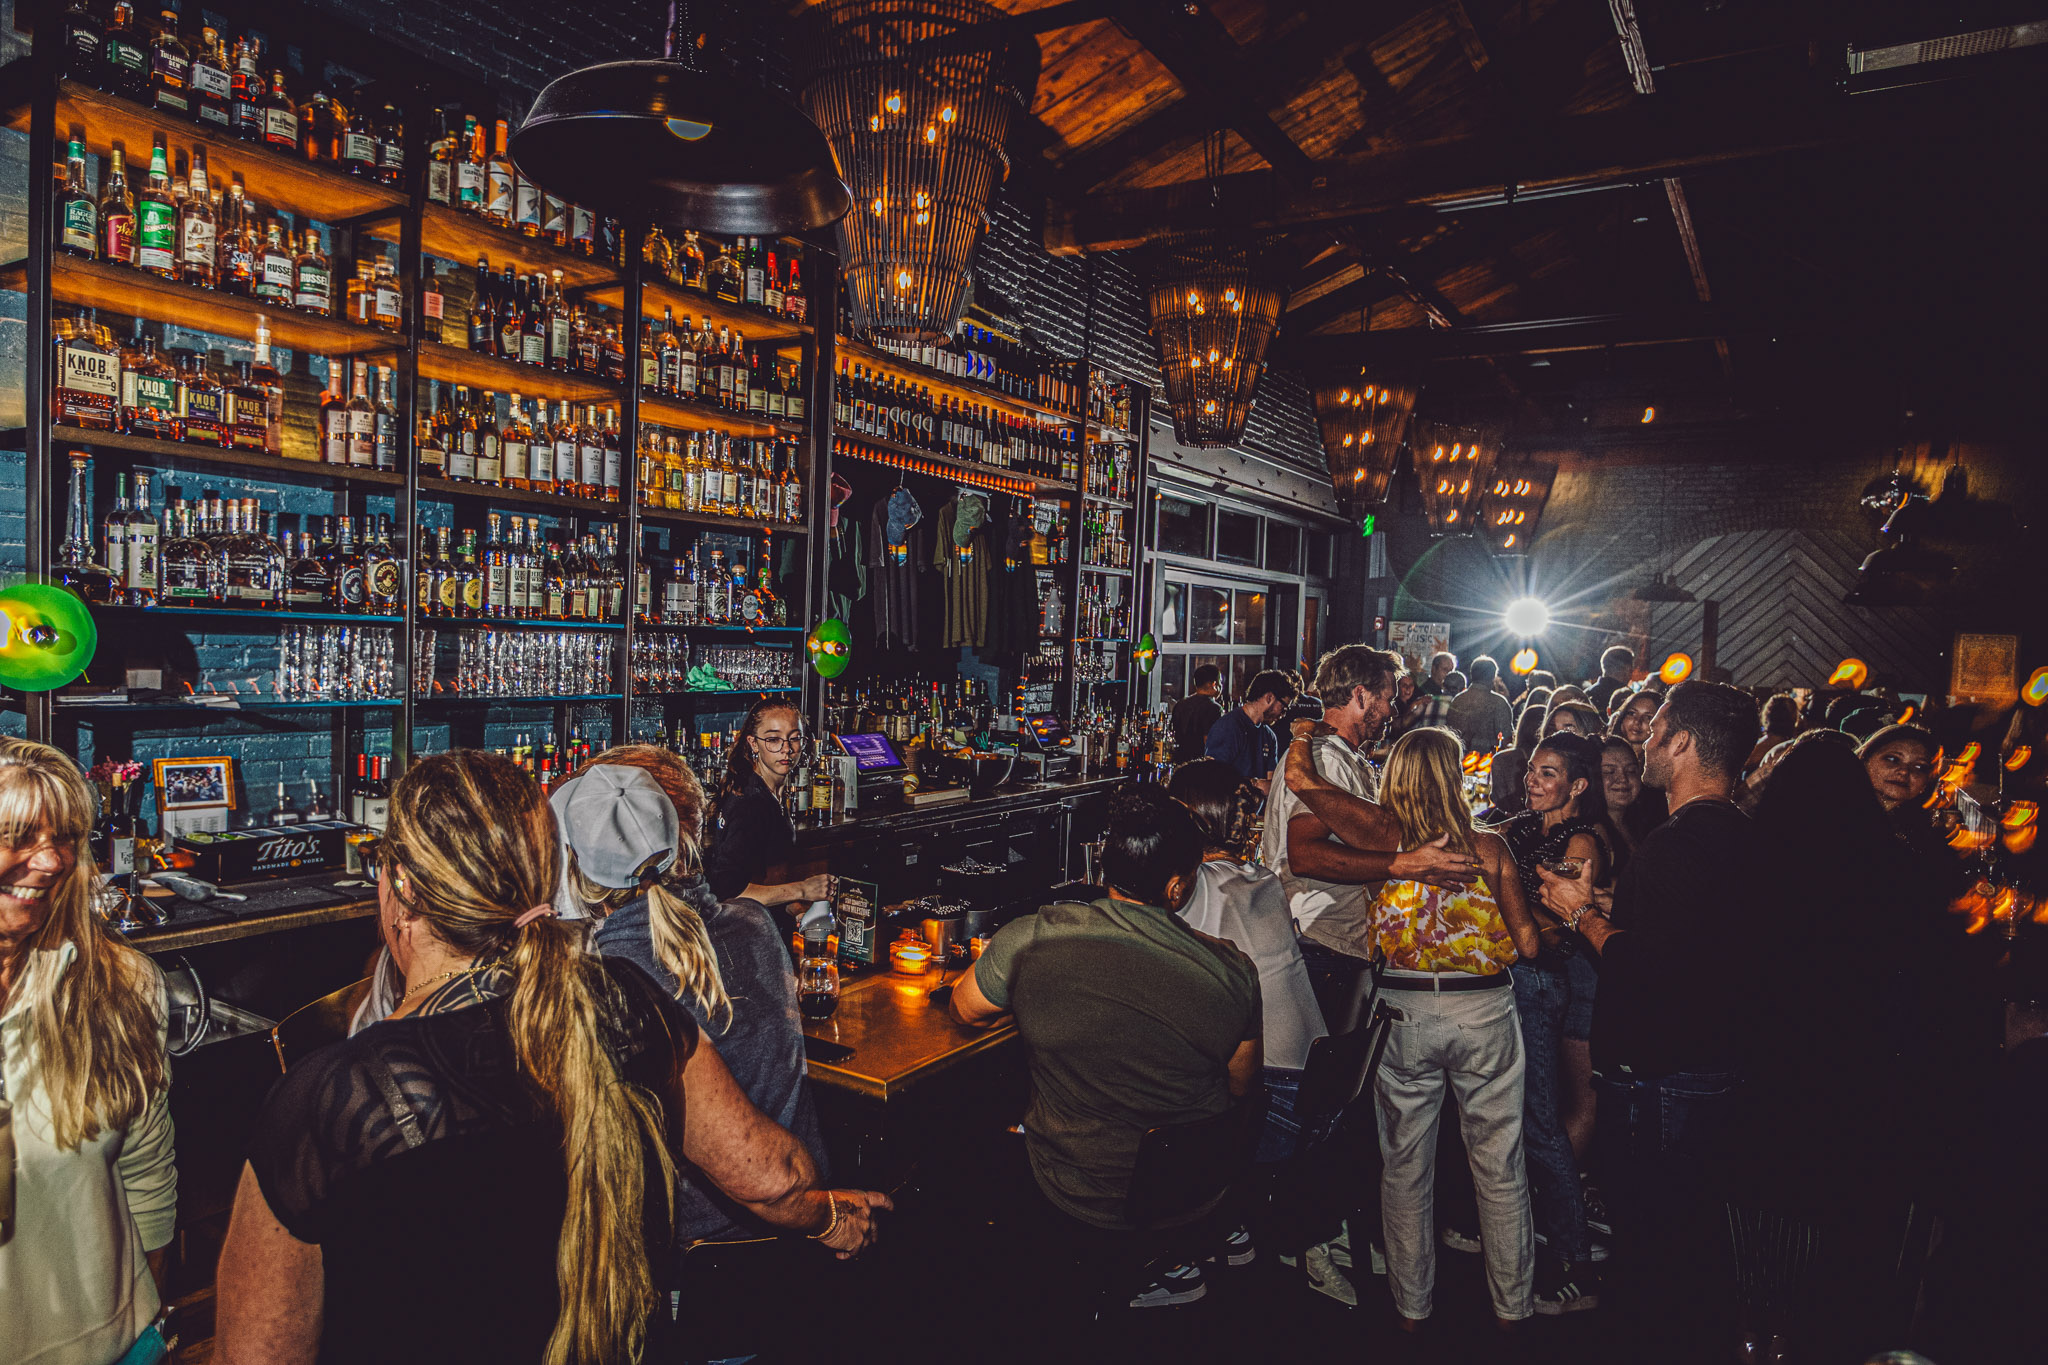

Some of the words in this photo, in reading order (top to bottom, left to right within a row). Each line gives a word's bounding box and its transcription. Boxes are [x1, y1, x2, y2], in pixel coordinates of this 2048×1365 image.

[160, 49, 188, 68] TULLAMORE
[68, 353, 106, 374] KNOB
[74, 369, 113, 381] CREEK
[110, 381, 117, 392] 9
[138, 379, 166, 394] KNOB
[143, 391, 171, 400] CREEK
[190, 391, 216, 407] KNOB
[168, 400, 173, 409] 7
[237, 399, 260, 413] KNOB
[1407, 624, 1446, 634] OCTOBER
[1406, 634, 1433, 643] MUSIC
[252, 861, 289, 871] HANDMADE
[302, 857, 324, 865] VODKA
